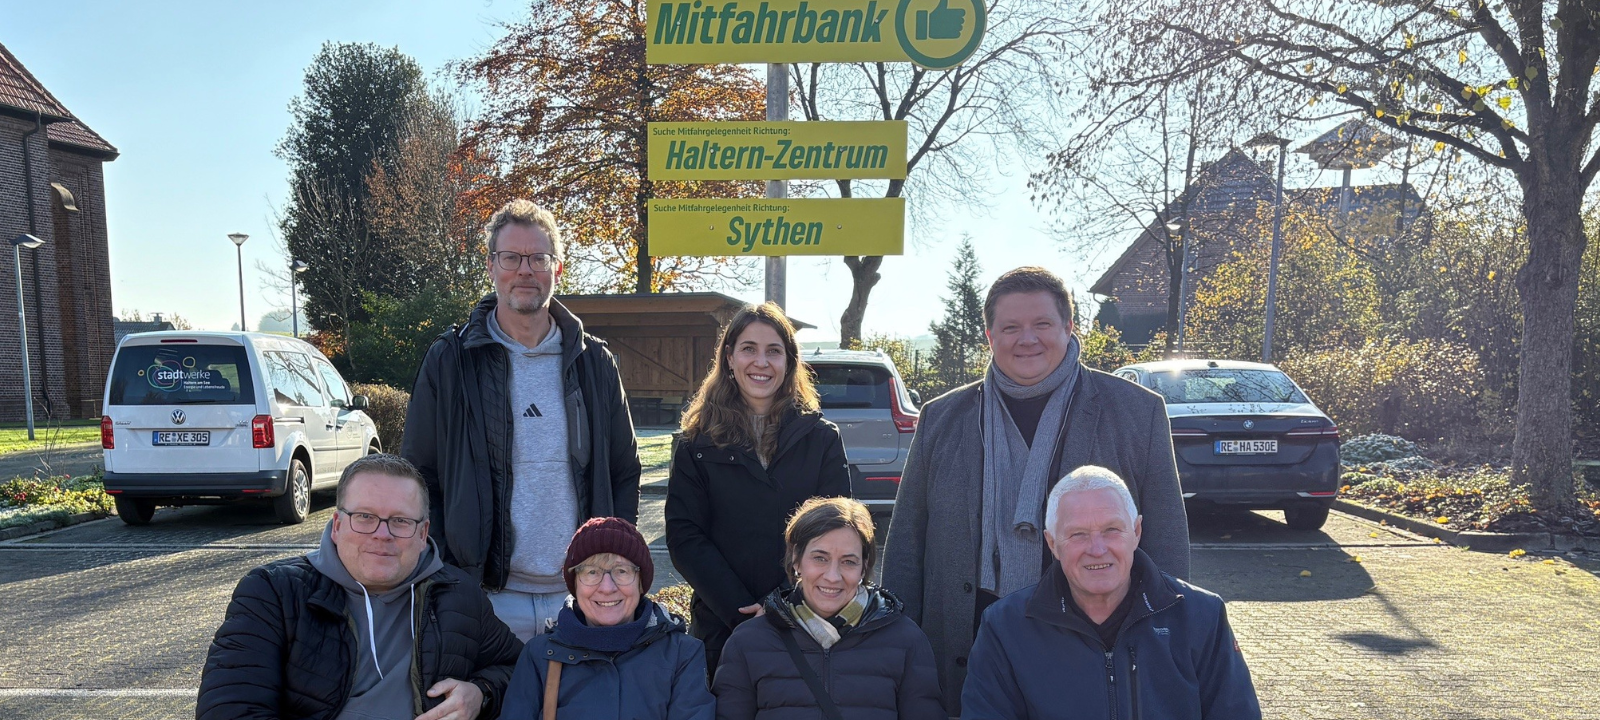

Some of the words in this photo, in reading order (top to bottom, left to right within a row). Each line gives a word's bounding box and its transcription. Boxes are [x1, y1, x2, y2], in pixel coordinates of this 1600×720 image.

[653, 0, 889, 45] Mitfahrbank
[652, 127, 676, 136] Suche
[677, 127, 751, 137] Mitfahrgelegenheit
[753, 127, 791, 137] Richtung:
[665, 139, 888, 169] Haltern-Zentrum
[653, 204, 677, 213] Suche
[678, 204, 751, 214] Mitfahrgelegenheit
[752, 204, 790, 213] Richtung:
[726, 216, 823, 253] Sythen
[157, 369, 211, 380] stadtwerke
[190, 433, 208, 442] 305
[1253, 442, 1276, 452] 530E
